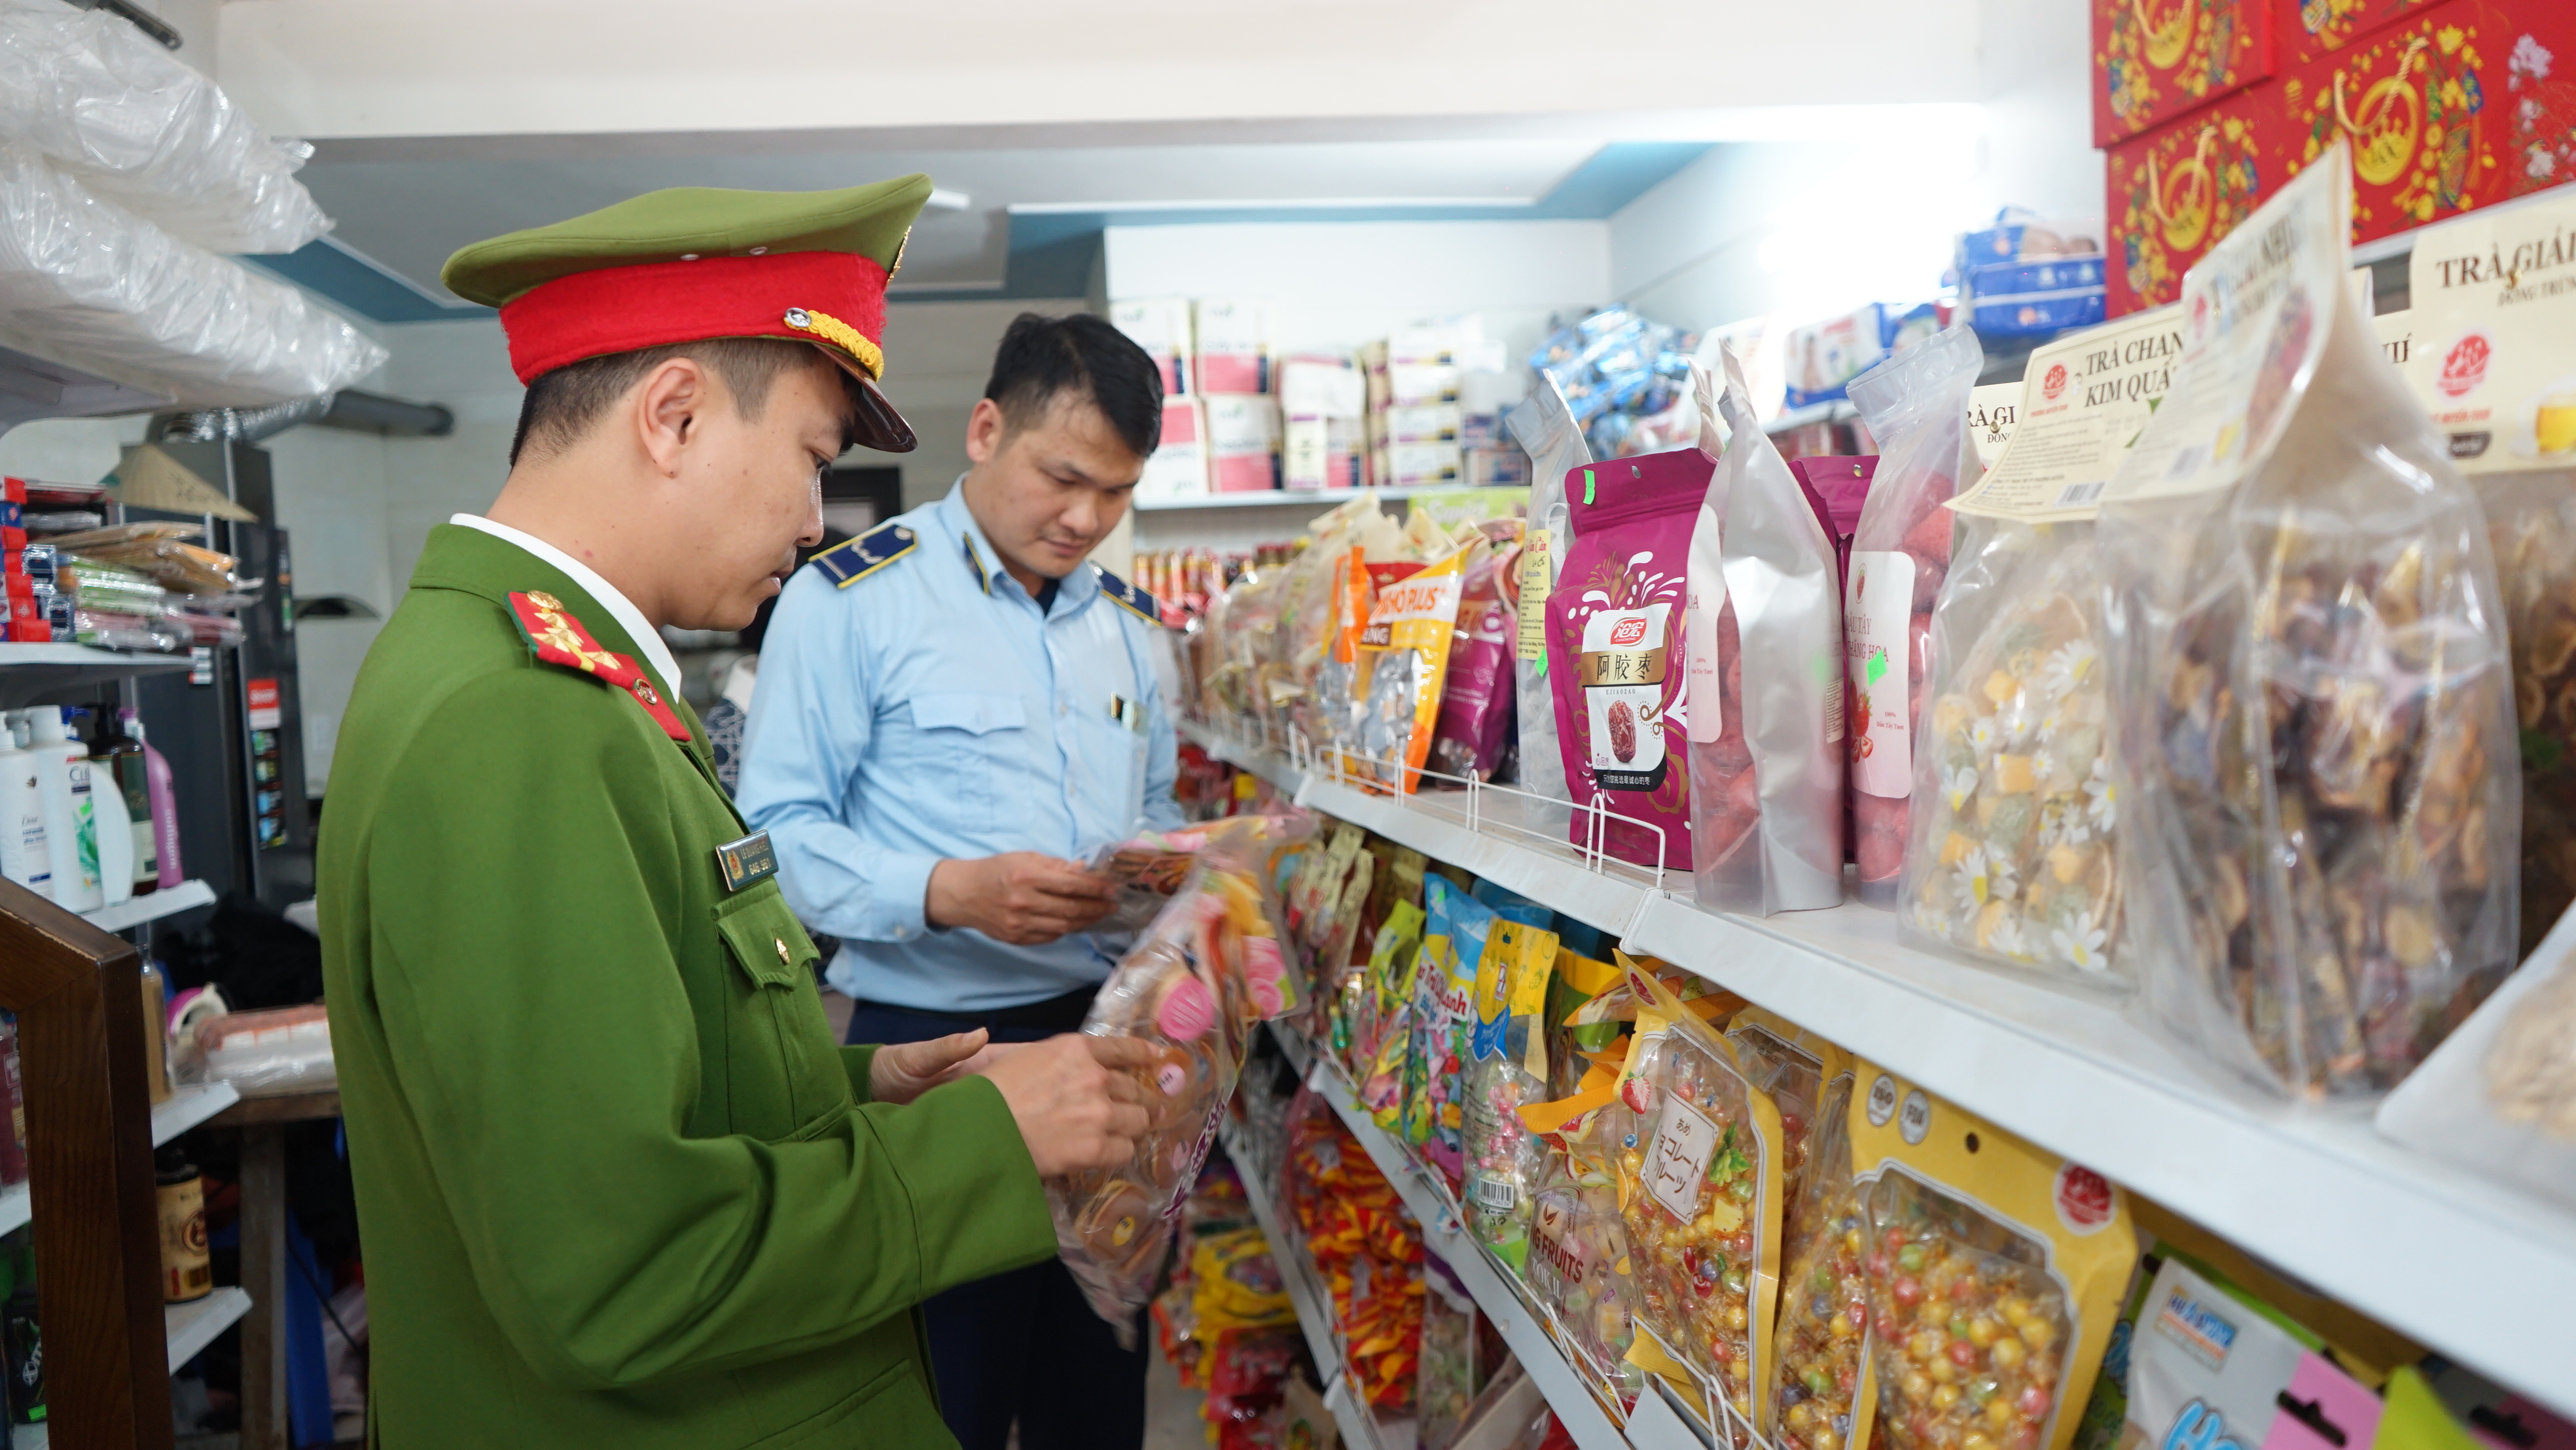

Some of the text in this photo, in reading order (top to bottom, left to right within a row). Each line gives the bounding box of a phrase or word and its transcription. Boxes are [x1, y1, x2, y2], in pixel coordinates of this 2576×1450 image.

[2435, 241, 2505, 289] TRÀ
[2086, 332, 2184, 377] TRÀ CHAN
[2084, 355, 2177, 407] KIM QUẤ
[1687, 594, 1699, 609] OA
[1614, 621, 1645, 639] 沧宏
[1597, 653, 1653, 682] 阿胶枣
[1675, 1118, 1691, 1136] あめ
[1659, 1134, 1699, 1178] ョコレート
[1541, 1234, 1584, 1284] FRUITS
